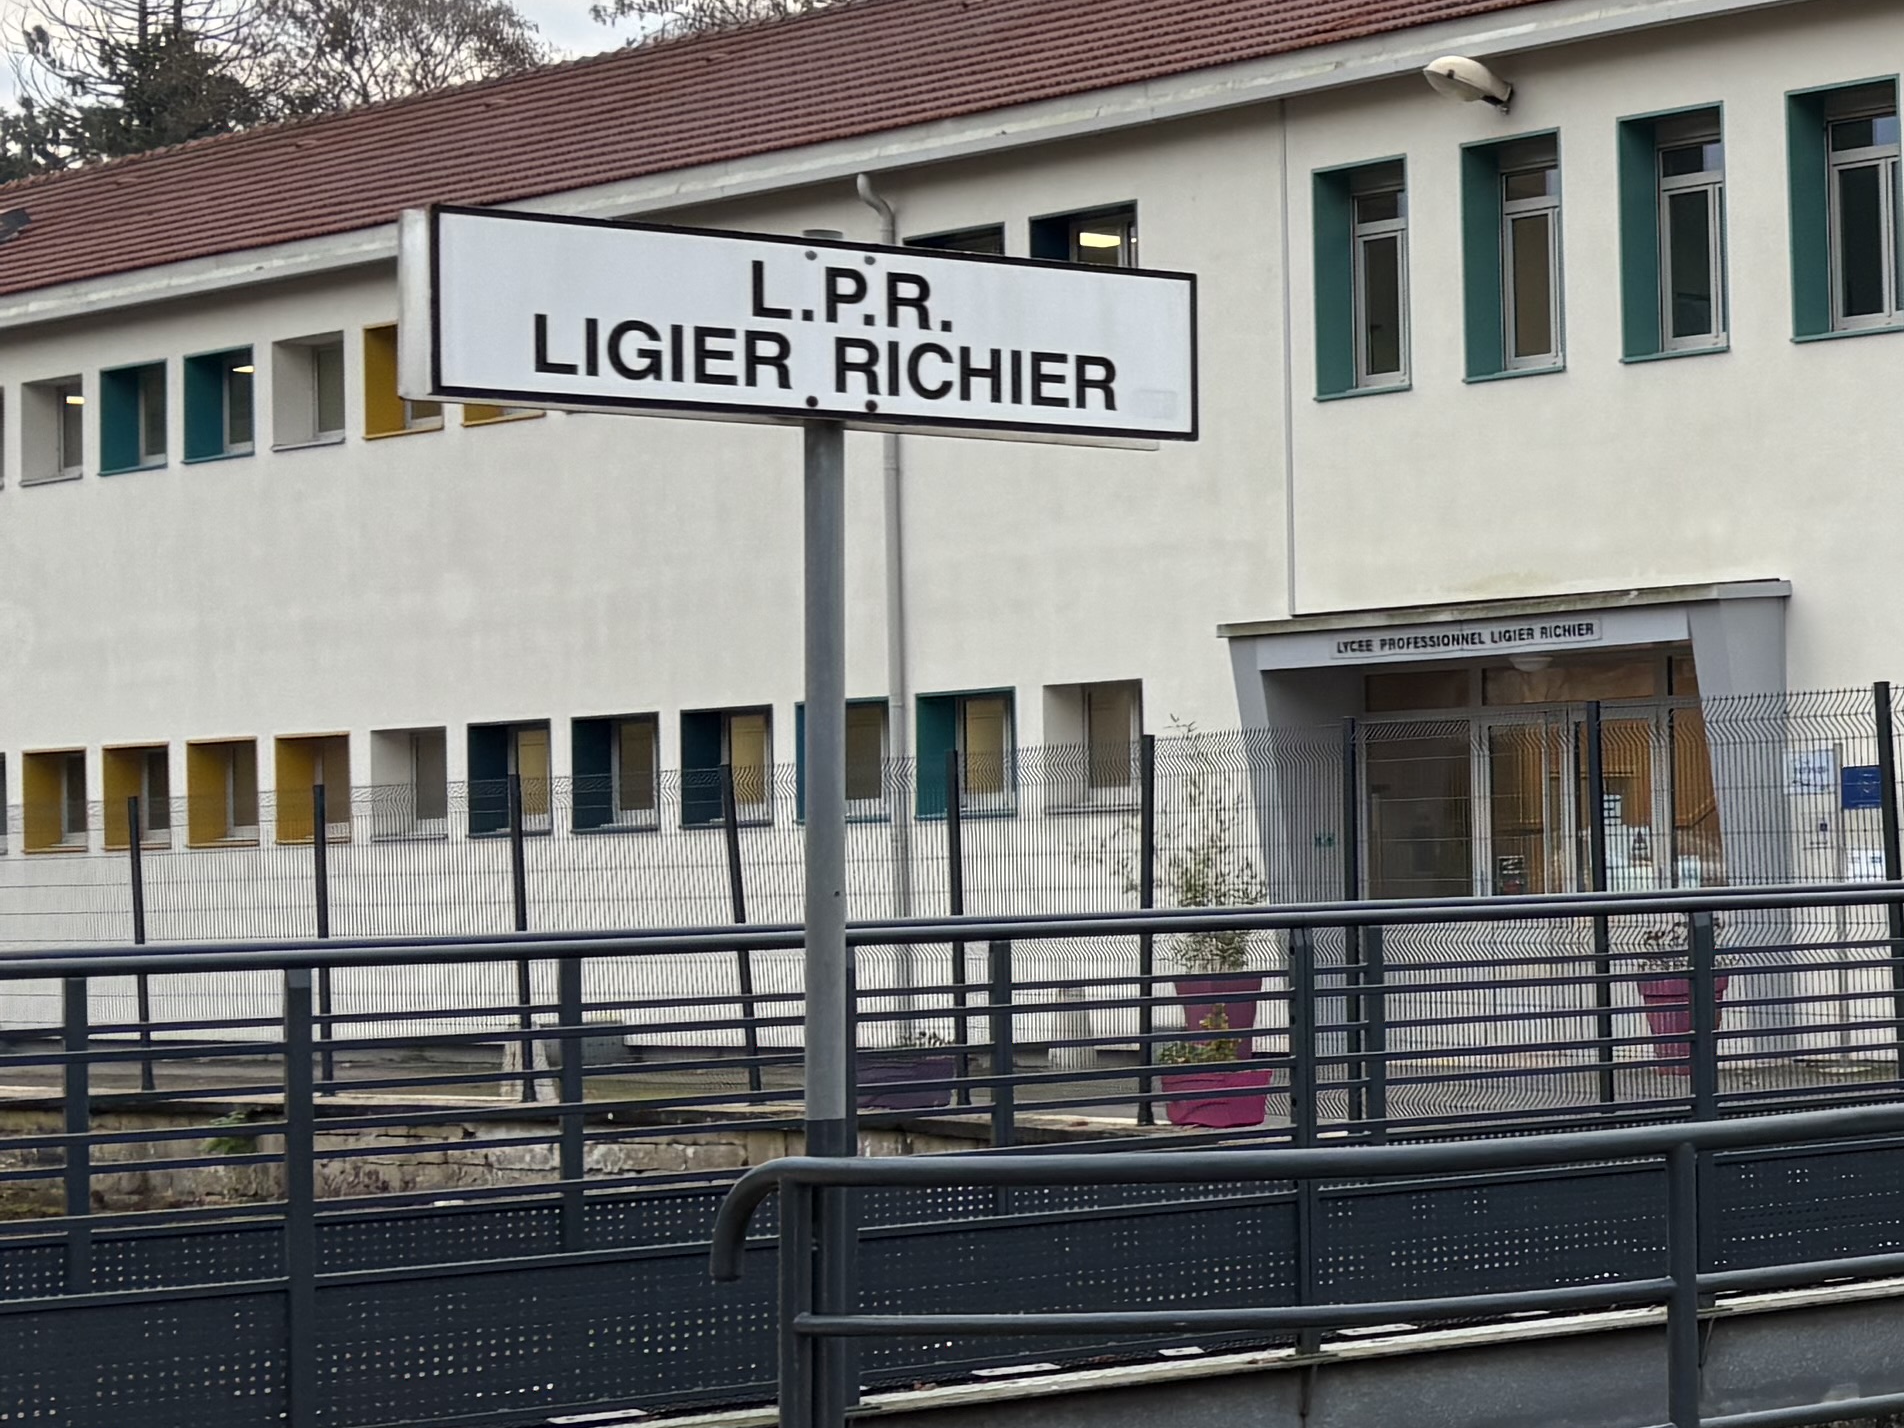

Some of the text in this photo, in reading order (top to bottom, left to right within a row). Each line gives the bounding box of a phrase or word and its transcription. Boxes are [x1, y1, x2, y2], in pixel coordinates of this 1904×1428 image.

[752, 258, 953, 335] L.P.R.
[534, 312, 1119, 412] LIGIER RICHIER
[1336, 622, 1594, 654] LYCEE PROFESSIONNEL LIGIER RICHIER
